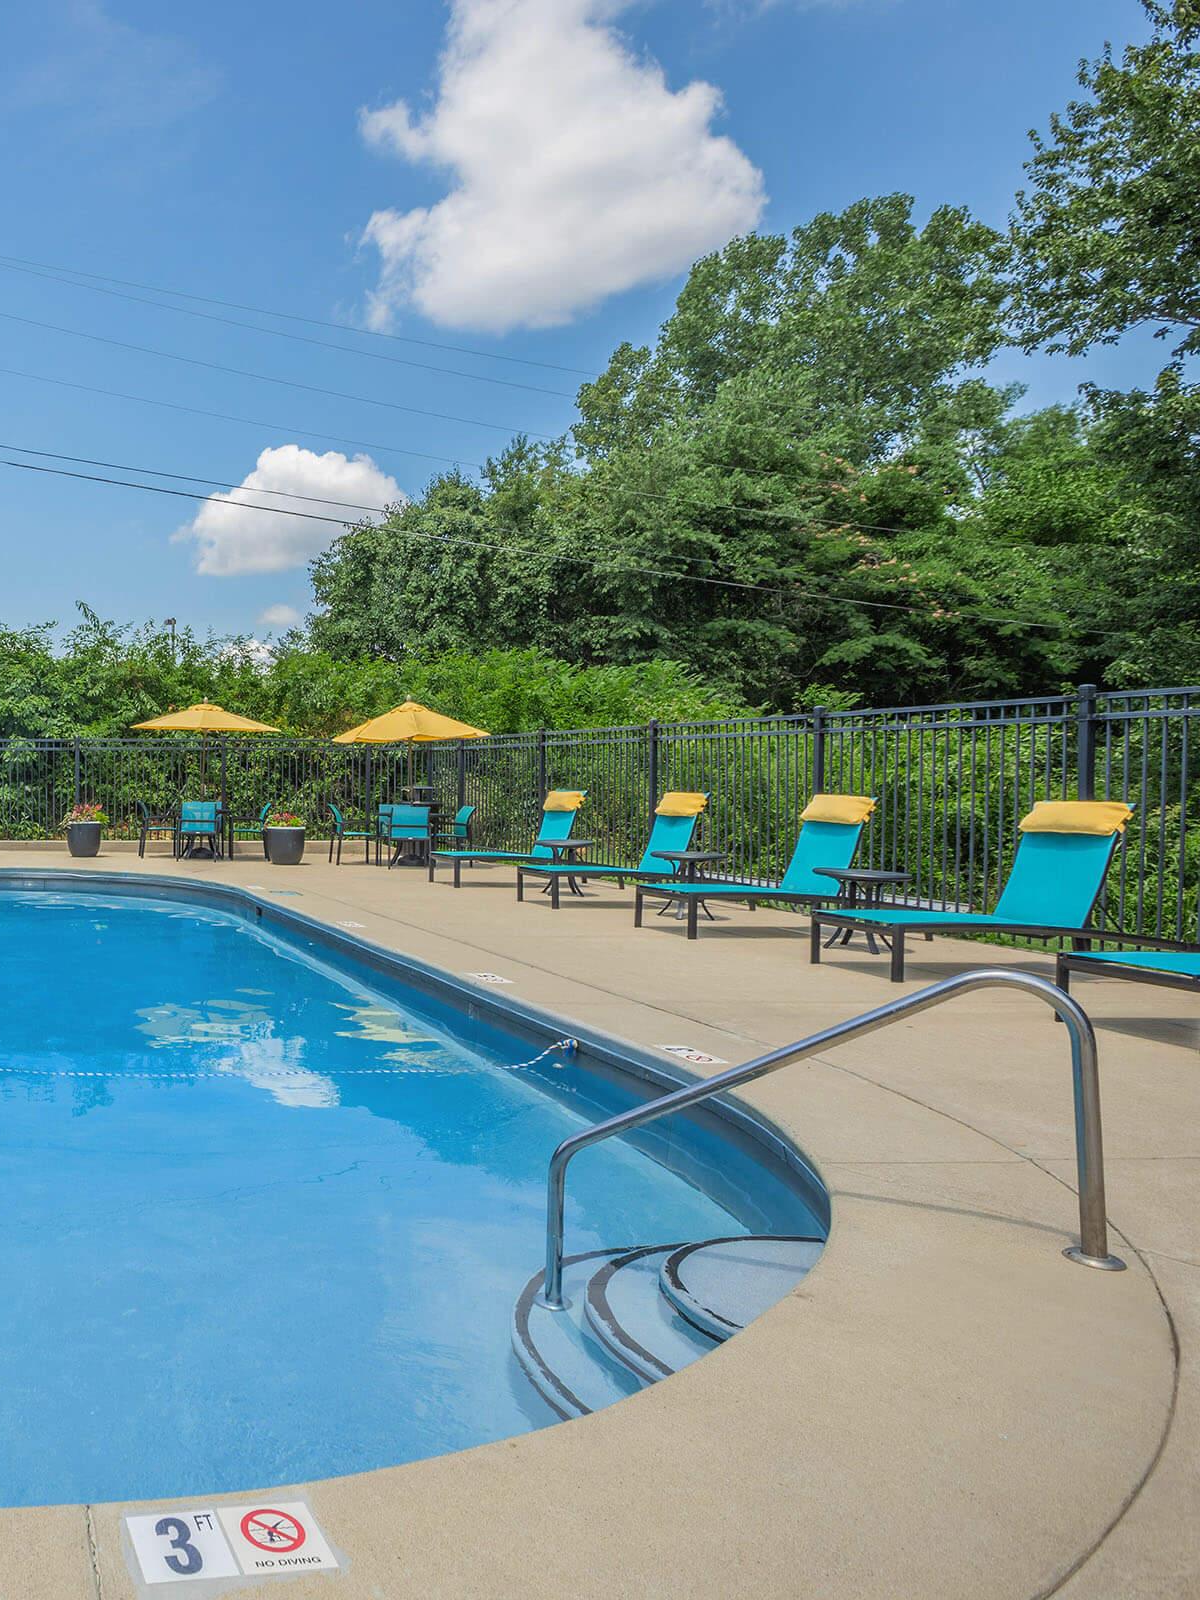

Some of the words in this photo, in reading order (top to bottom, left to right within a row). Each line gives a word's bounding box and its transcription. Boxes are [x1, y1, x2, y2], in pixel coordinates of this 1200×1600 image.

[155, 1517, 203, 1575] 3
[193, 1514, 214, 1532] FT
[255, 1558, 275, 1568] NO
[278, 1556, 322, 1567] DIVING
